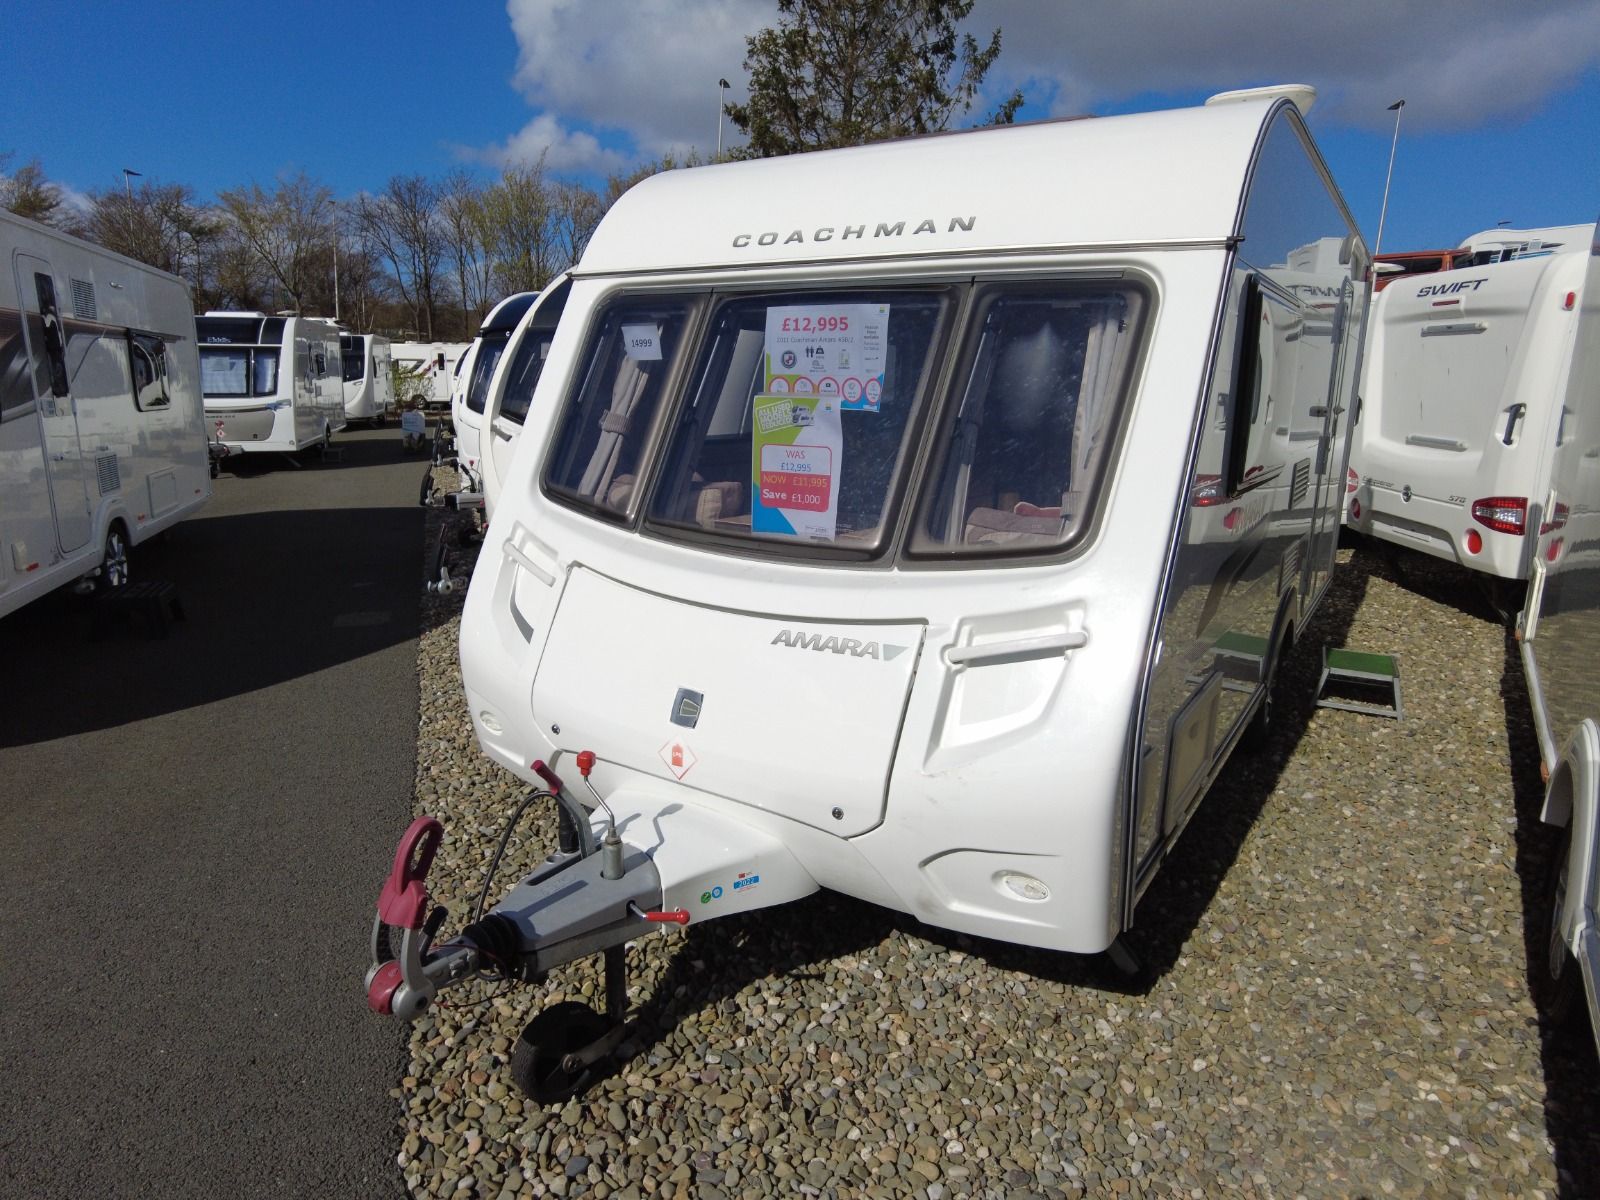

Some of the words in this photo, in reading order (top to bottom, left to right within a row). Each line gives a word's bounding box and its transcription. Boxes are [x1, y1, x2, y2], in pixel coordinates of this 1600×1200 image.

[732, 216, 976, 248] COACHMAN
[1417, 279, 1488, 297] SWIFT
[782, 316, 849, 333] £12,995
[631, 338, 653, 348] 14999
[785, 450, 806, 459] WAS
[781, 462, 812, 473] £12,995
[763, 475, 787, 485] NOW
[763, 489, 787, 500] Save
[792, 493, 821, 505] £1,000
[770, 629, 879, 660] AMARA
